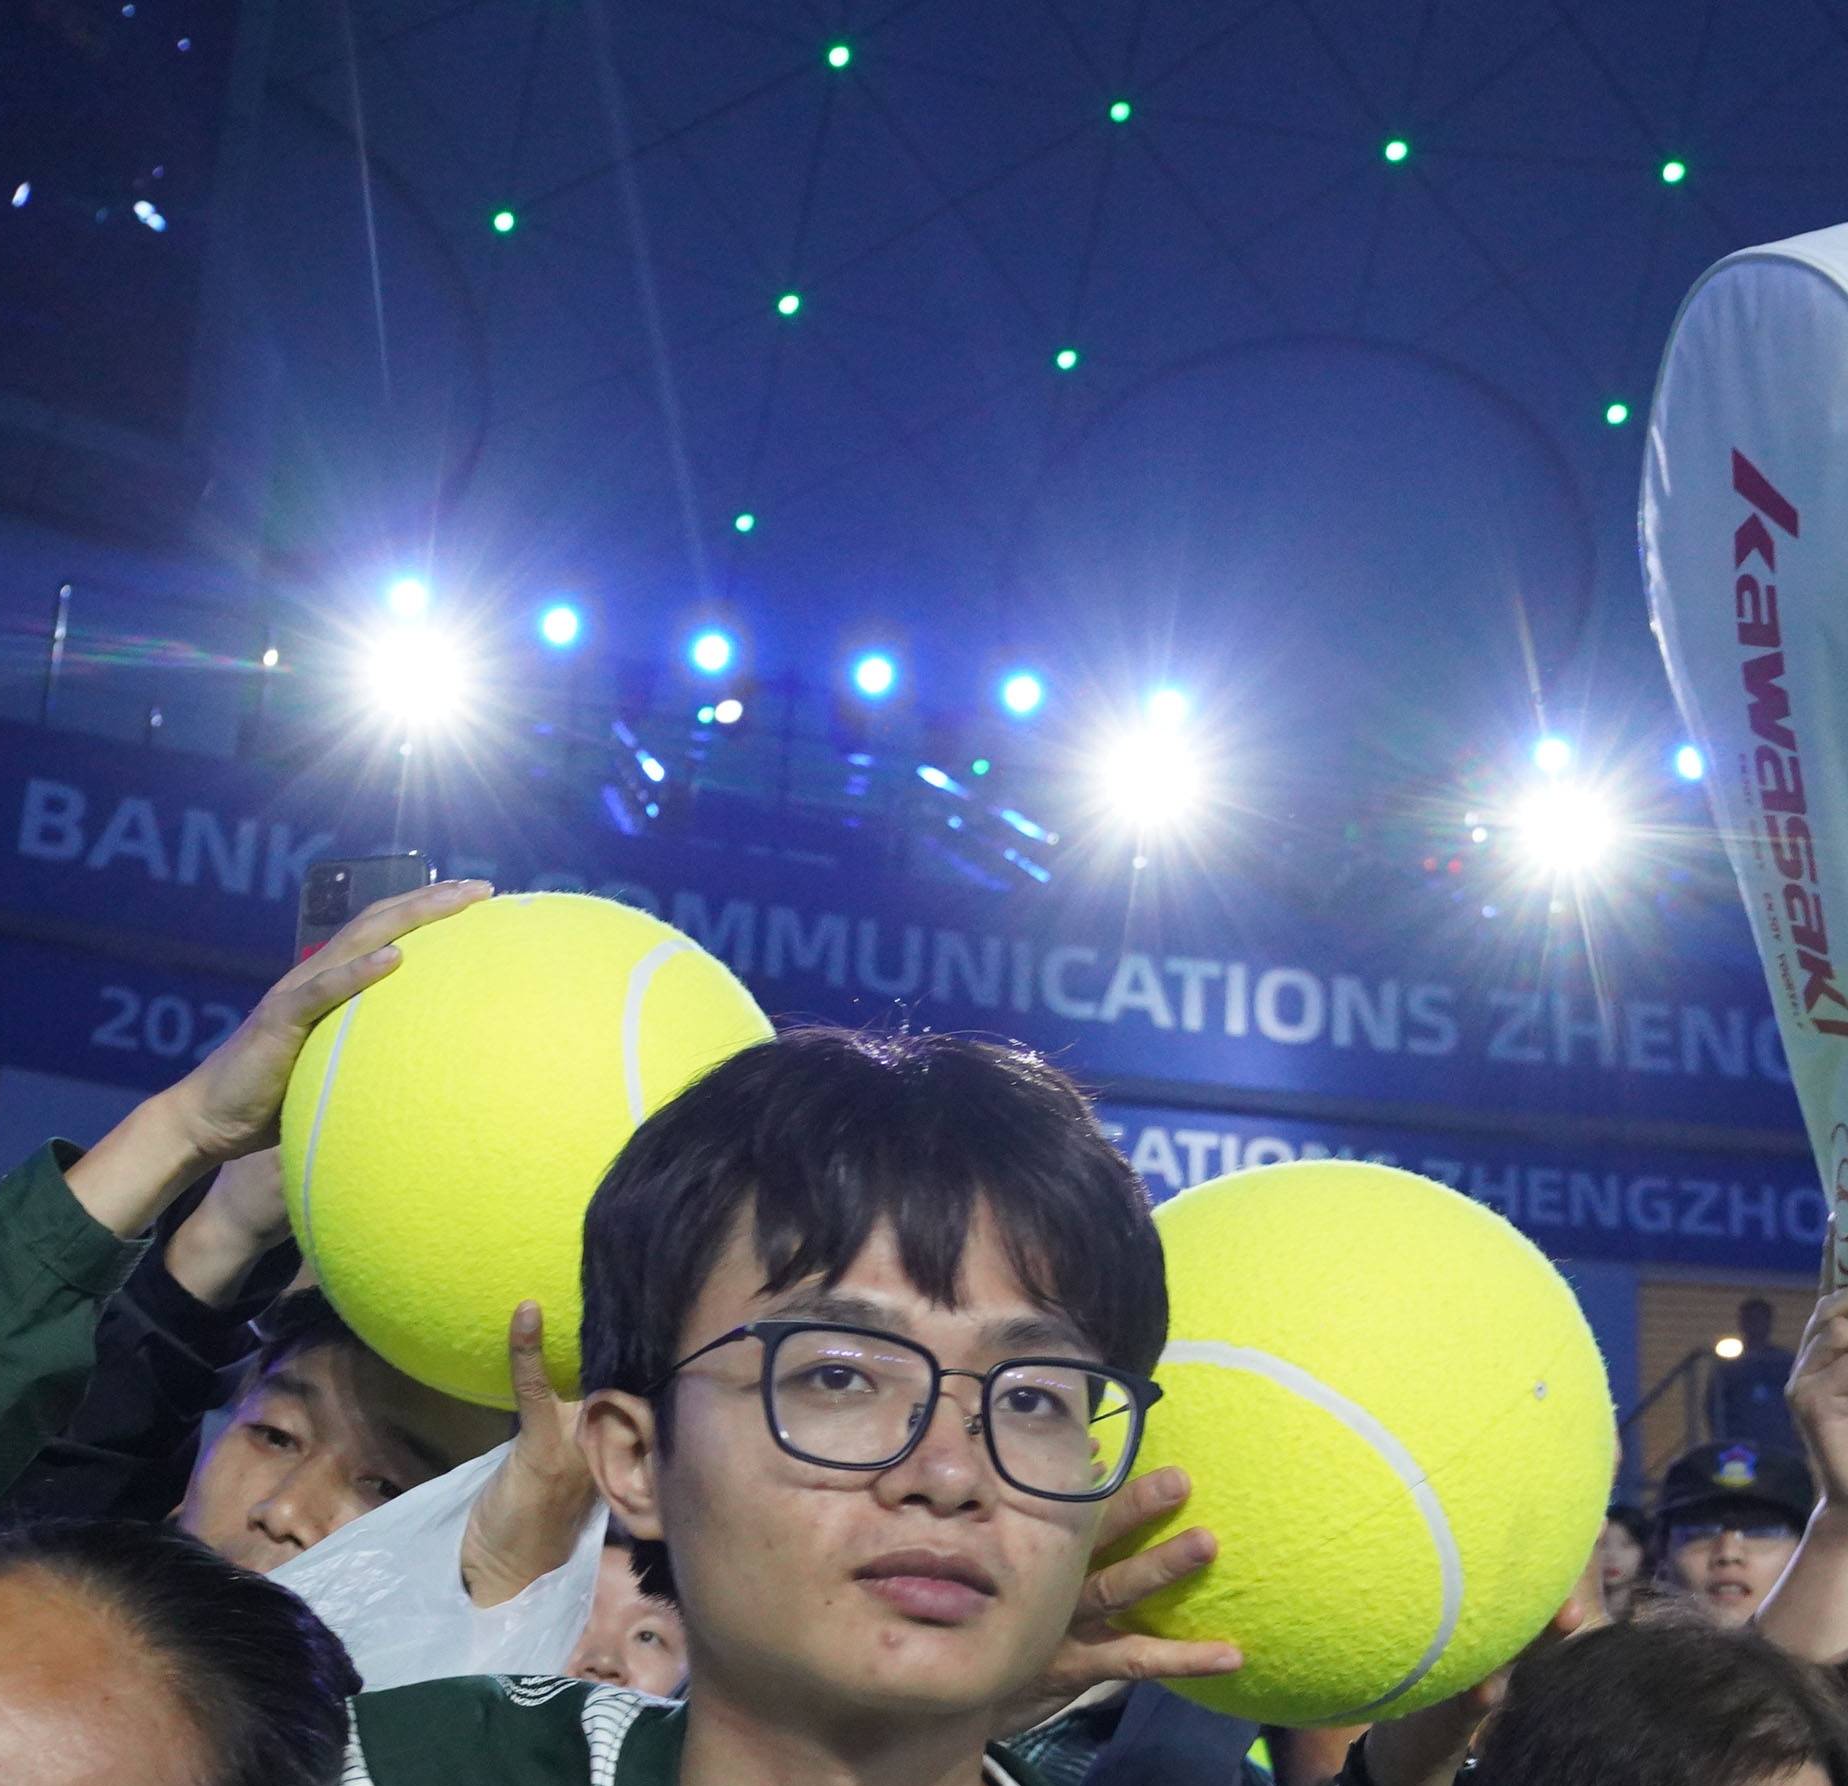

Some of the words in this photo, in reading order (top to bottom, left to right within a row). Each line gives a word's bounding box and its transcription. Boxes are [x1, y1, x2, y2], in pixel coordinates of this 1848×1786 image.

[18, 777, 337, 901] BANK
[530, 873, 1459, 1057] MMUNICATIONS
[90, 986, 241, 1062] 202
